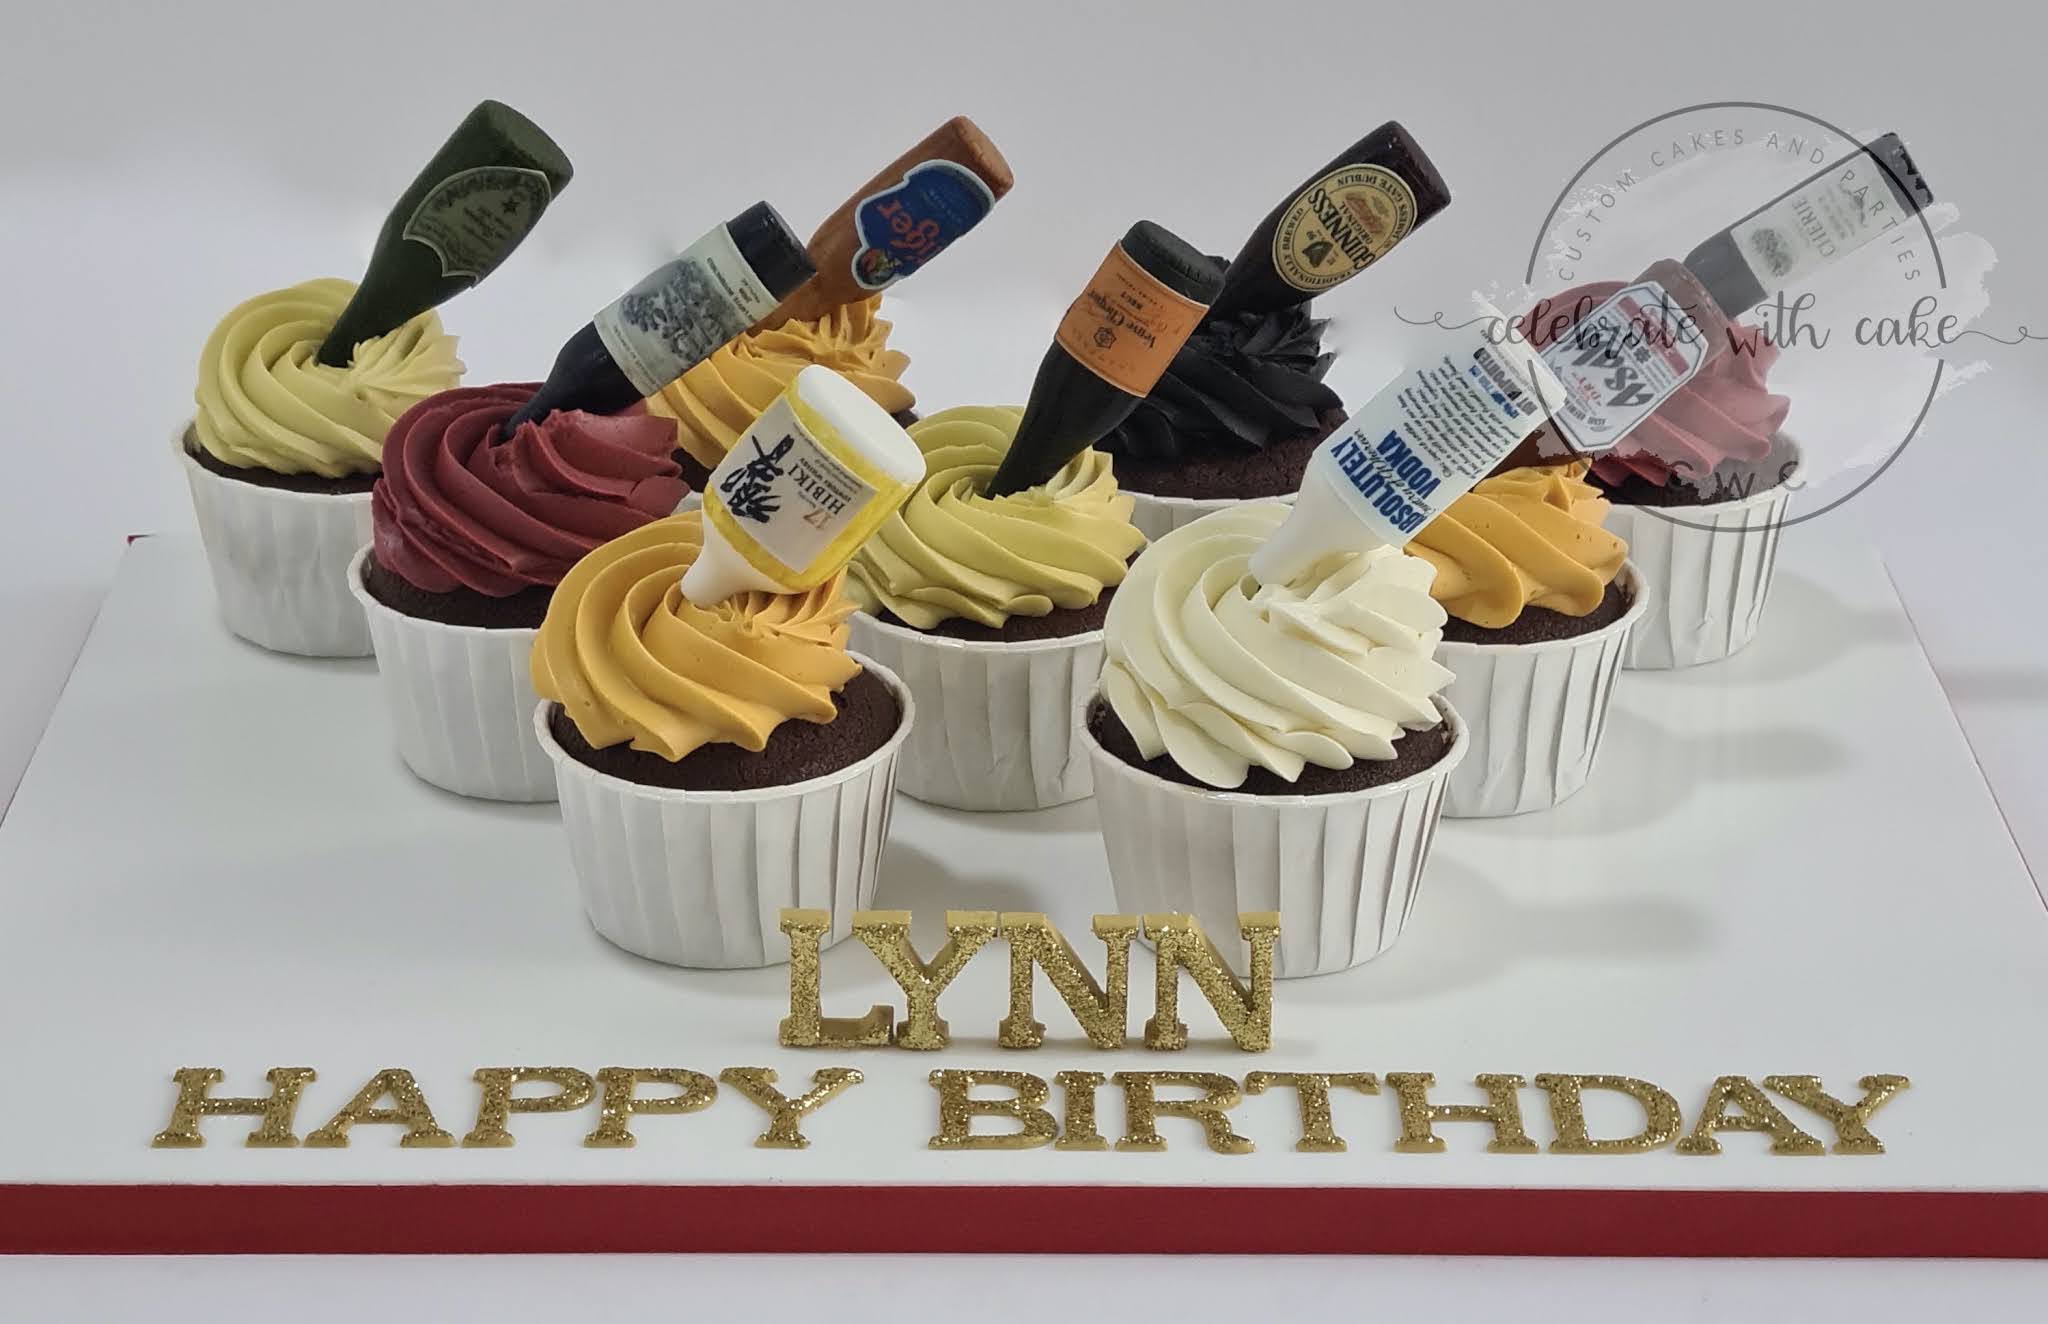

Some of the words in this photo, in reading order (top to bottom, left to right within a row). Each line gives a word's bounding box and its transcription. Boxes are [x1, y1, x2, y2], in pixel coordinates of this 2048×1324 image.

[1335, 172, 1377, 184] DUBLIN
[1376, 176, 1404, 202] GATE
[1279, 206, 1304, 251] BREWED
[1305, 188, 1376, 271] GUINNESS
[1338, 200, 1374, 245] ORIGINAL
[1376, 428, 1441, 499] VODKA
[785, 461, 846, 517] HIBIKI
[802, 505, 832, 530] 17
[780, 909, 1280, 1051] LYNN
[152, 1066, 865, 1150] HAPPY
[927, 1068, 1911, 1155] BIRTHDAY
